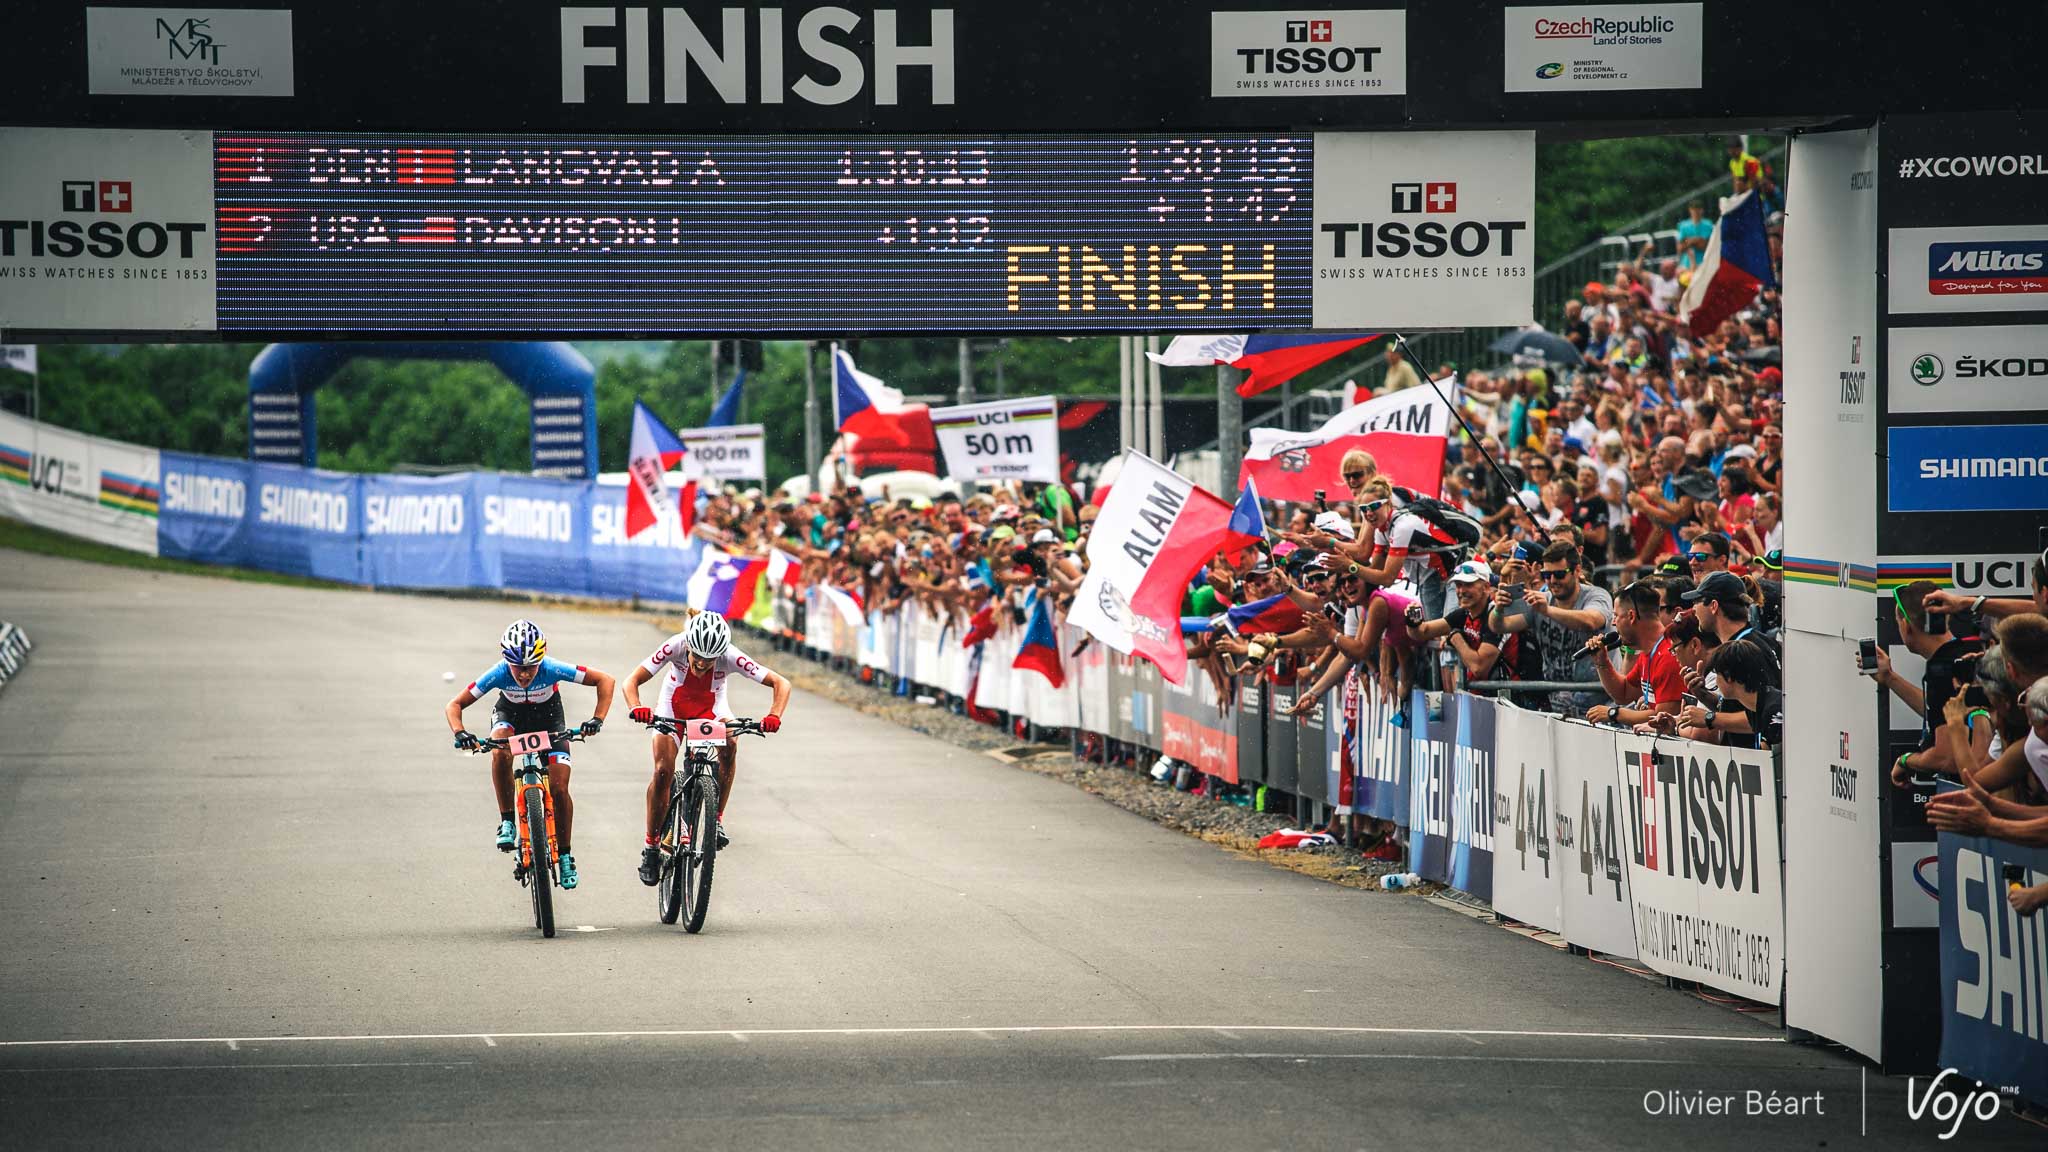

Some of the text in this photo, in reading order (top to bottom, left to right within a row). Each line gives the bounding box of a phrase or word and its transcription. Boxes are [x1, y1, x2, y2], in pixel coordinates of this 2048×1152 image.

[1593, 35, 1662, 46] Land of Stories
[560, 6, 955, 106] FINISH
[1236, 47, 1382, 74] TISSOT
[120, 67, 203, 77] MINISTERSTVO
[178, 78, 185, 86] A
[1236, 79, 1382, 89] SWISS WATCHES SINCE 1853
[1898, 154, 2048, 178] #XCOWORL
[0, 220, 207, 259] TISSOT
[1320, 220, 1527, 259] TISSOT
[44, 267, 115, 279] WATCHES
[123, 268, 168, 280] SINCE
[176, 269, 208, 280] 1853
[1320, 266, 1526, 279] SWISS WATCHES SINCE 1853
[1938, 250, 2044, 273] Mitas
[1007, 244, 1276, 311] FINISH
[1942, 281, 1994, 293] Designed
[1997, 280, 2018, 292] for
[1955, 355, 2048, 378] ŠKOD
[977, 411, 1010, 426] UCI
[964, 433, 1033, 456] 50 m
[30, 452, 64, 494] UCI
[165, 472, 246, 518] SHIMANO
[259, 484, 348, 533] SHIMANO
[366, 494, 464, 535] SHIMANO
[484, 495, 571, 543] SHIMANO
[1956, 561, 2025, 589] UCI
[699, 721, 713, 736] 6
[517, 734, 541, 751] 10
[1830, 764, 1858, 803] TISSOT
[1453, 744, 1494, 852] BIRELL
[1657, 754, 1762, 894] TISSOT
[1638, 901, 1771, 989] SWISS WATCHES SINCE 1853
